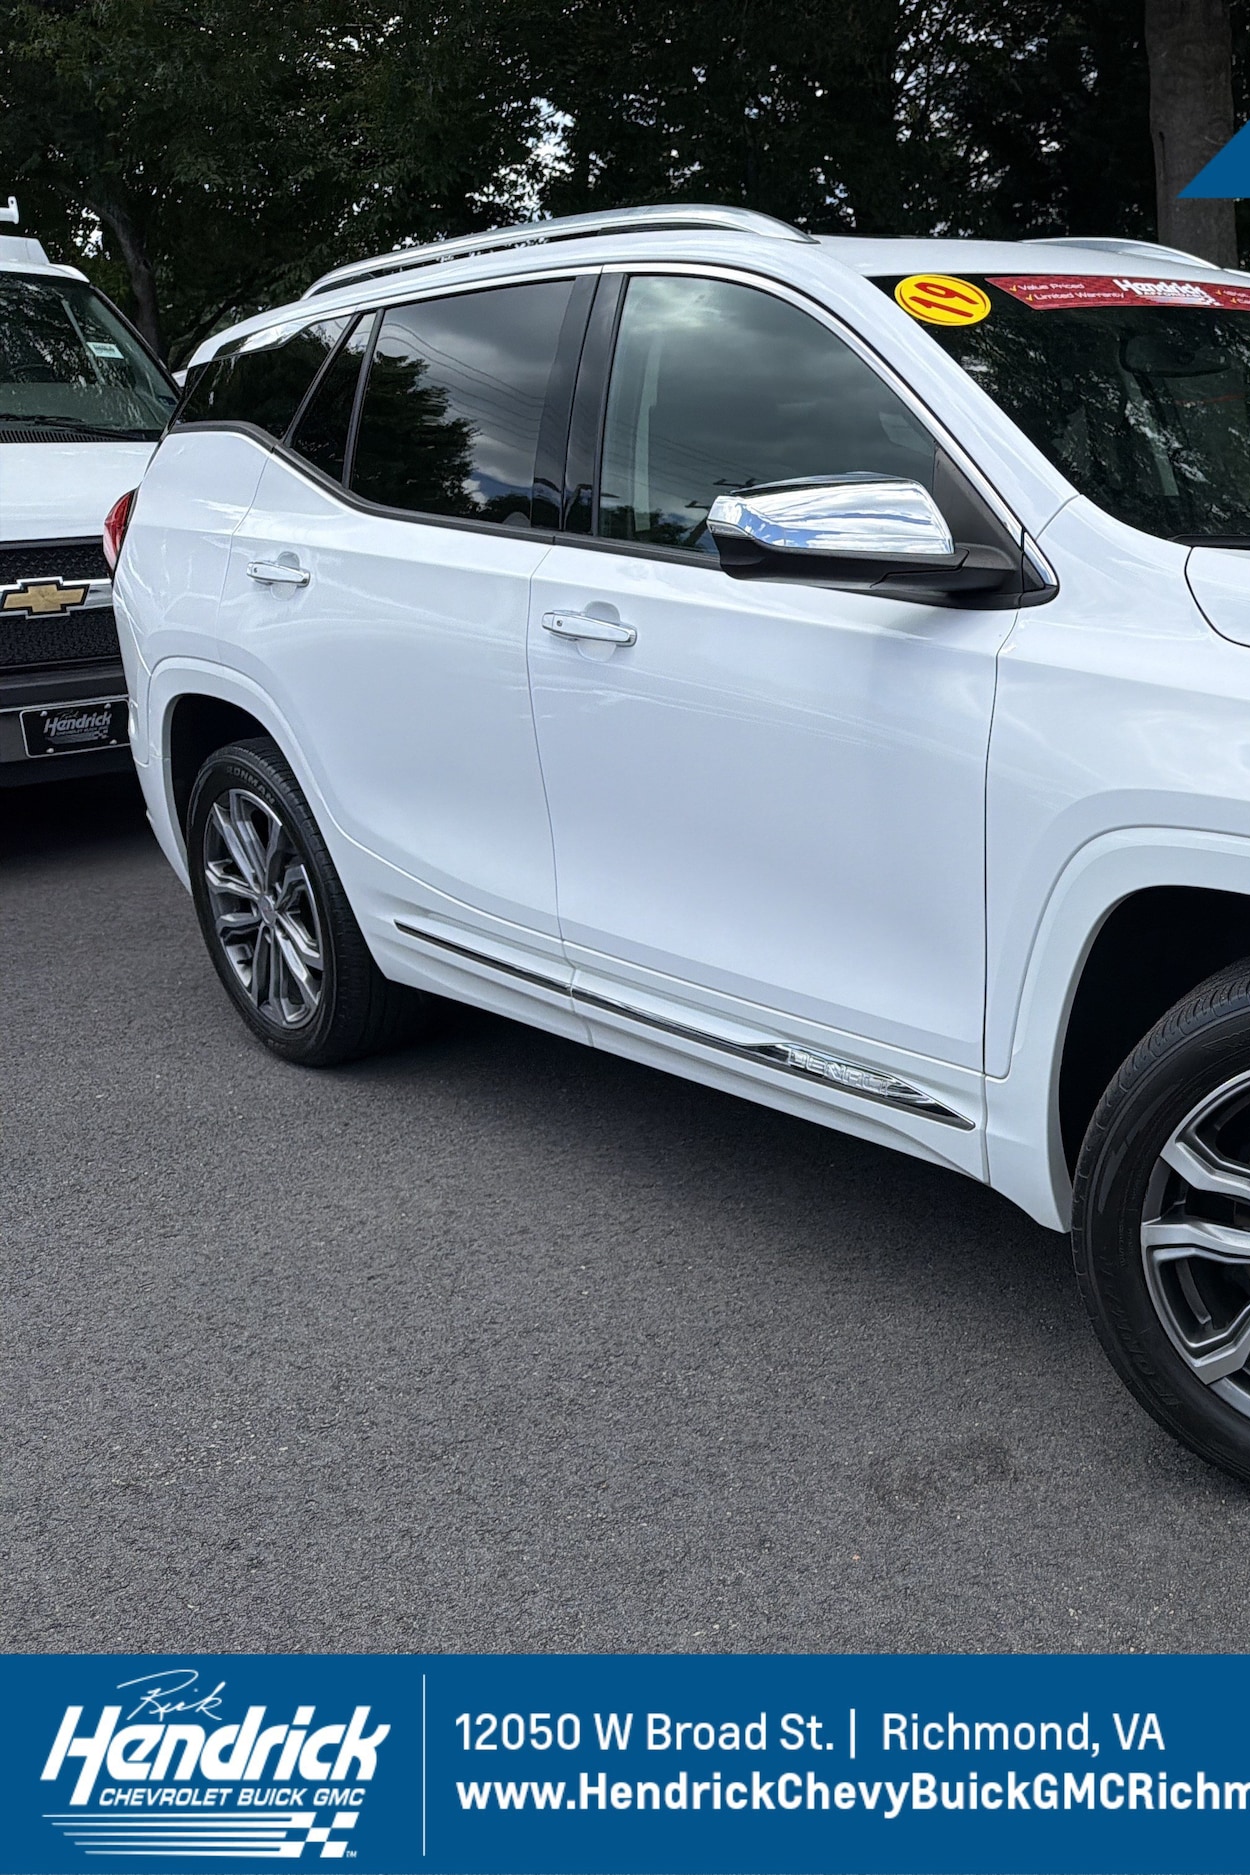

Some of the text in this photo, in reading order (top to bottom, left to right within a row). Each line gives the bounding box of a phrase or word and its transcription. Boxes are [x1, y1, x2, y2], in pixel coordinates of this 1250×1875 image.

[909, 282, 979, 318] 19
[1034, 292, 1074, 300] Limited
[1112, 279, 1210, 299] Hendrick
[43, 711, 112, 737] Hendrick
[223, 765, 276, 804] RONMAN
